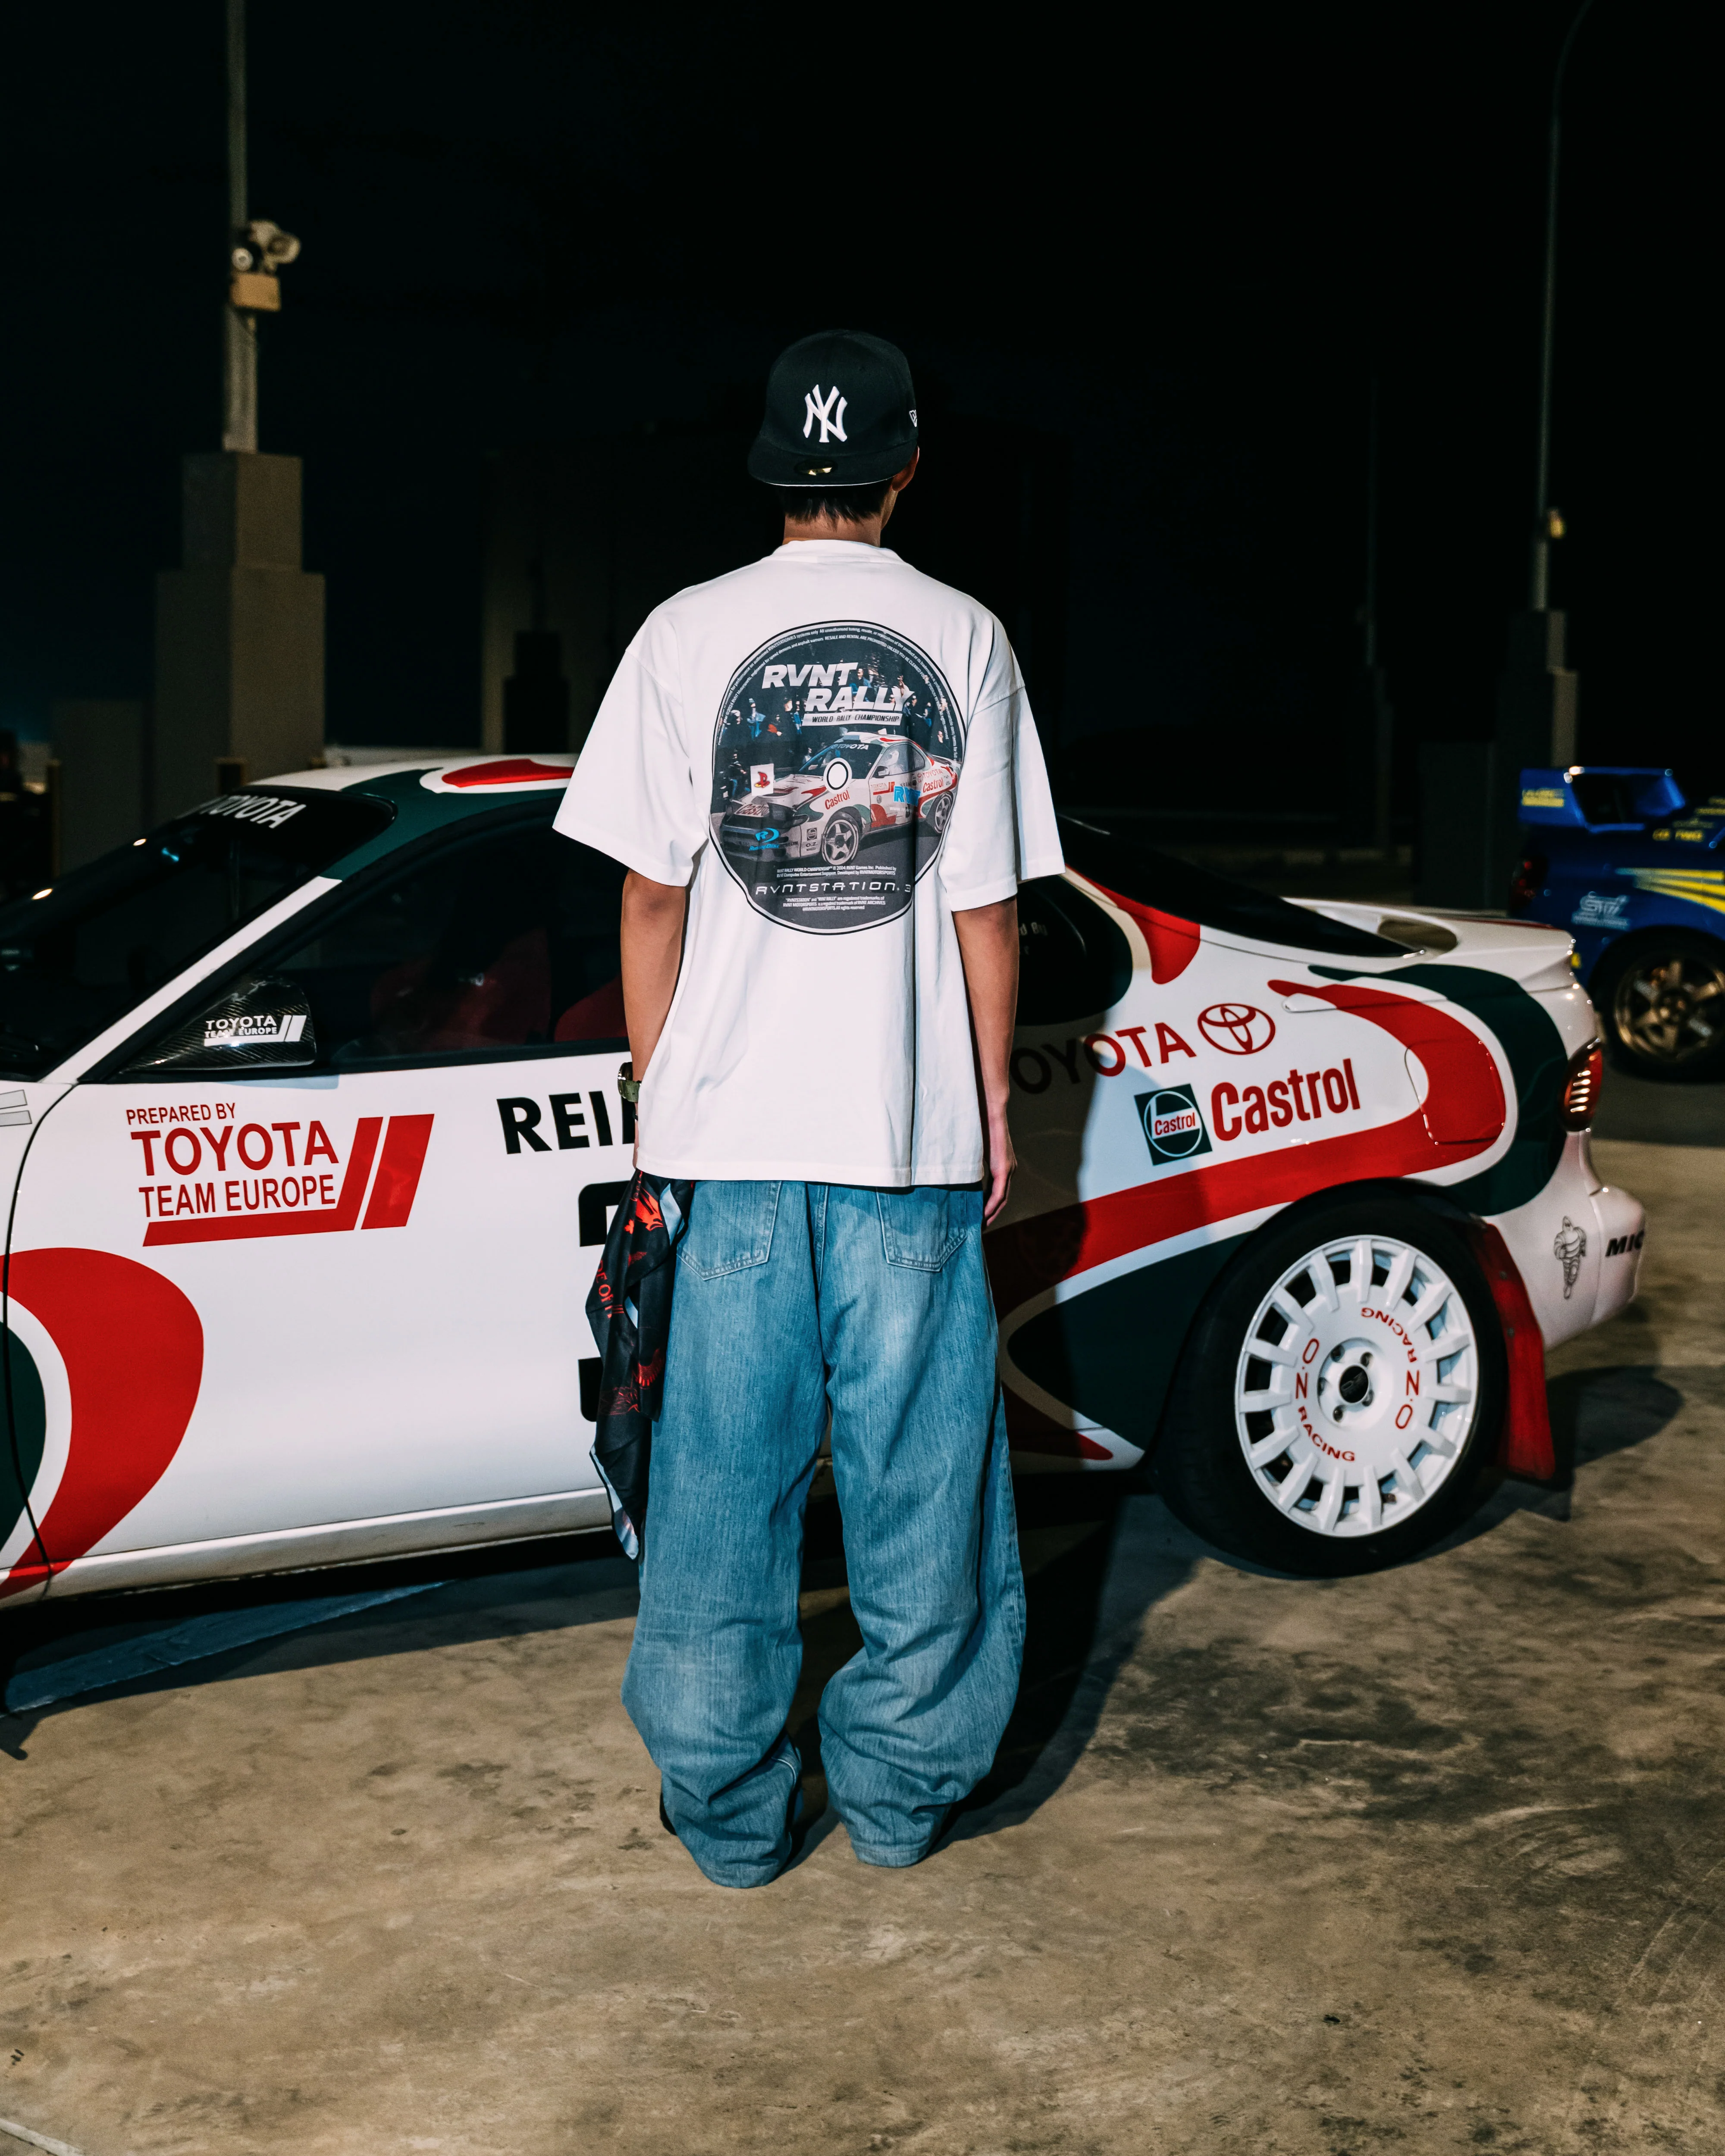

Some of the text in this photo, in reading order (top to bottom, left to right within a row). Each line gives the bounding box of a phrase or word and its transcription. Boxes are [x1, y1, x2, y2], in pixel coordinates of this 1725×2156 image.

[803, 384, 848, 443] NY
[762, 662, 859, 689] RVNT
[804, 686, 915, 711] RALLY
[854, 714, 900, 722] CHAMPIONSHIP
[923, 769, 943, 779] TOYOTA
[923, 777, 944, 793] Castrol
[825, 790, 850, 810] Castrol
[206, 1015, 277, 1030] TOYOTA
[238, 1027, 277, 1035] EUROPE
[1010, 1022, 1197, 1095] OYOTA
[1211, 1058, 1361, 1142] Castrol
[125, 1102, 236, 1125] PREPARED BY
[1154, 1111, 1195, 1136] Castrol
[131, 1120, 339, 1176] TOYOTA
[138, 1174, 336, 1218] TEAM EUROPE
[1361, 1307, 1418, 1363] RACING
[1298, 1406, 1355, 1462] RACING
